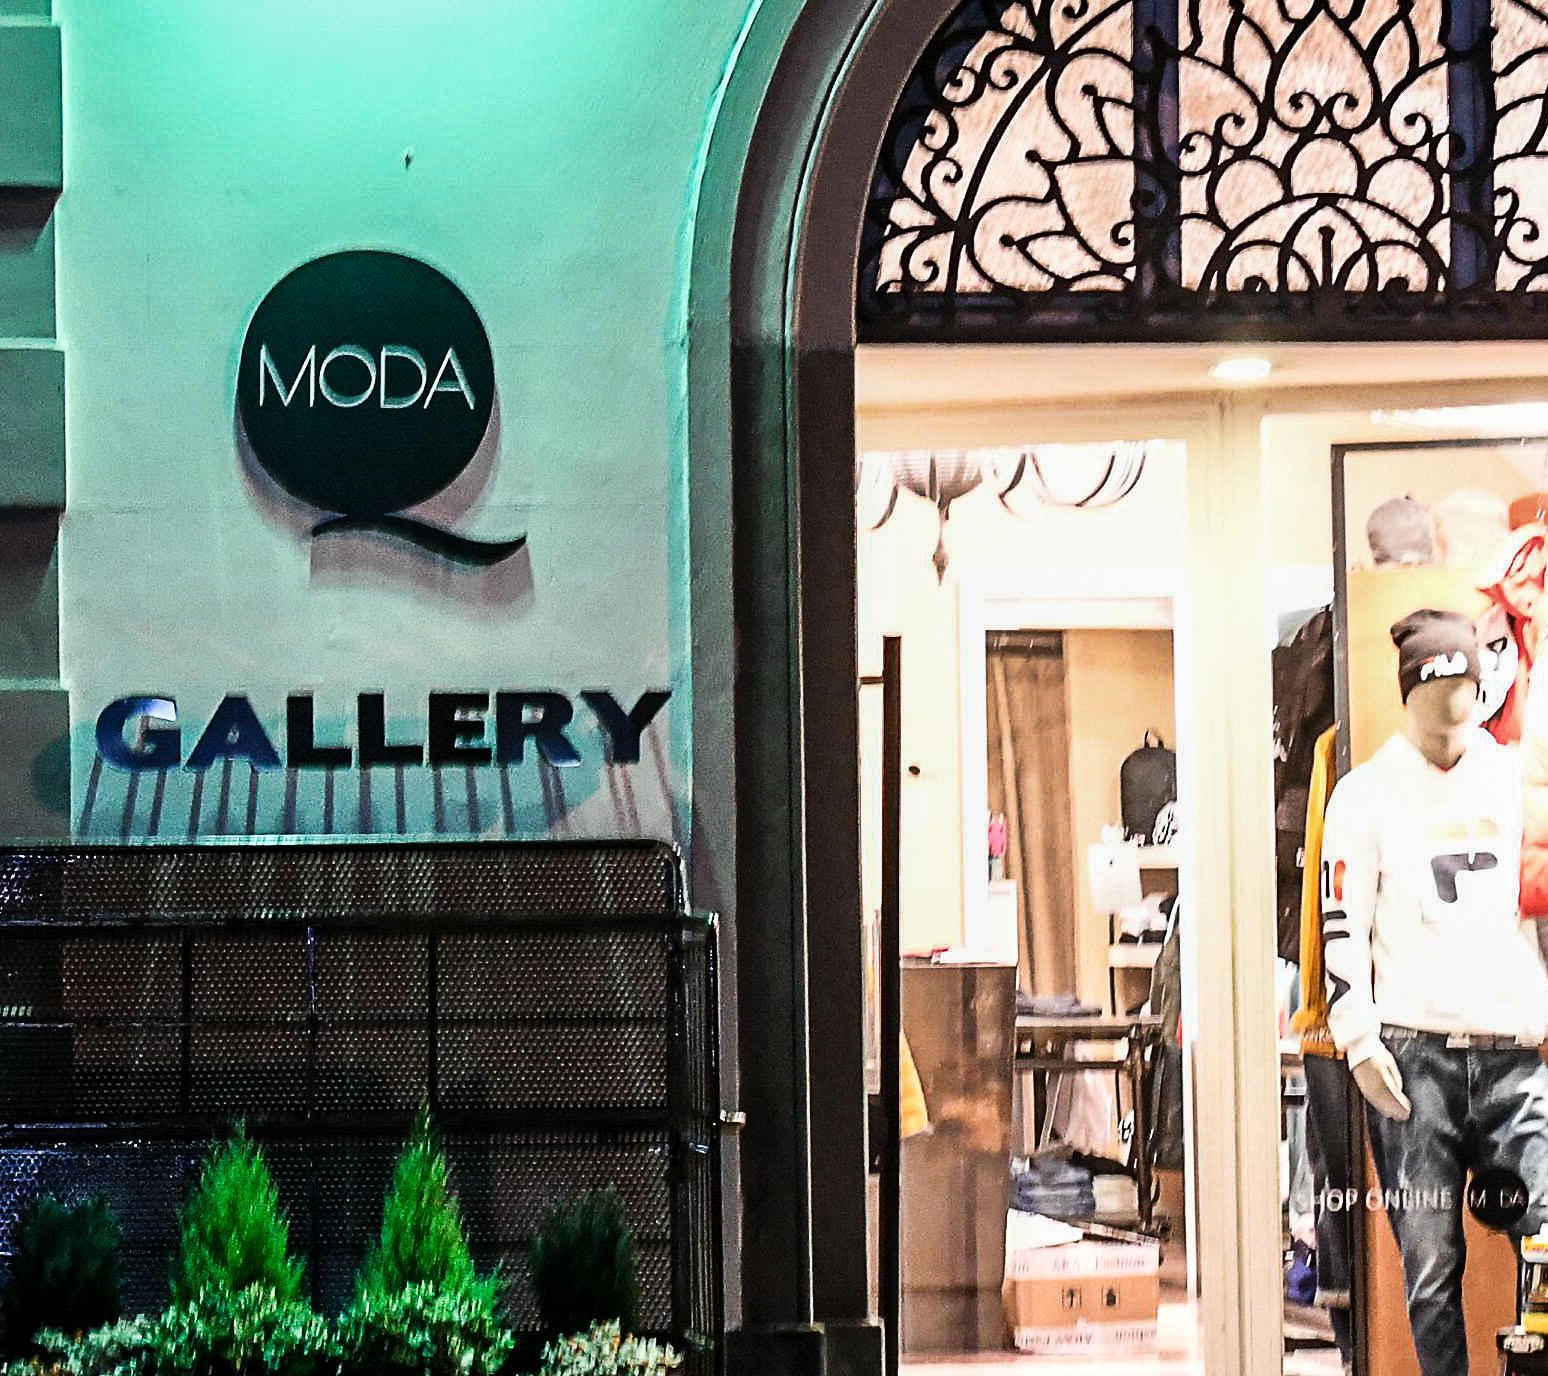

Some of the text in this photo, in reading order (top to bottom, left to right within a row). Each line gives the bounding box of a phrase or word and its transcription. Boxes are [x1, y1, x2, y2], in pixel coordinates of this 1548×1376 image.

[258, 344, 476, 410] MODA
[96, 689, 672, 769] GALLERY
[1309, 1188, 1358, 1213] HOP
